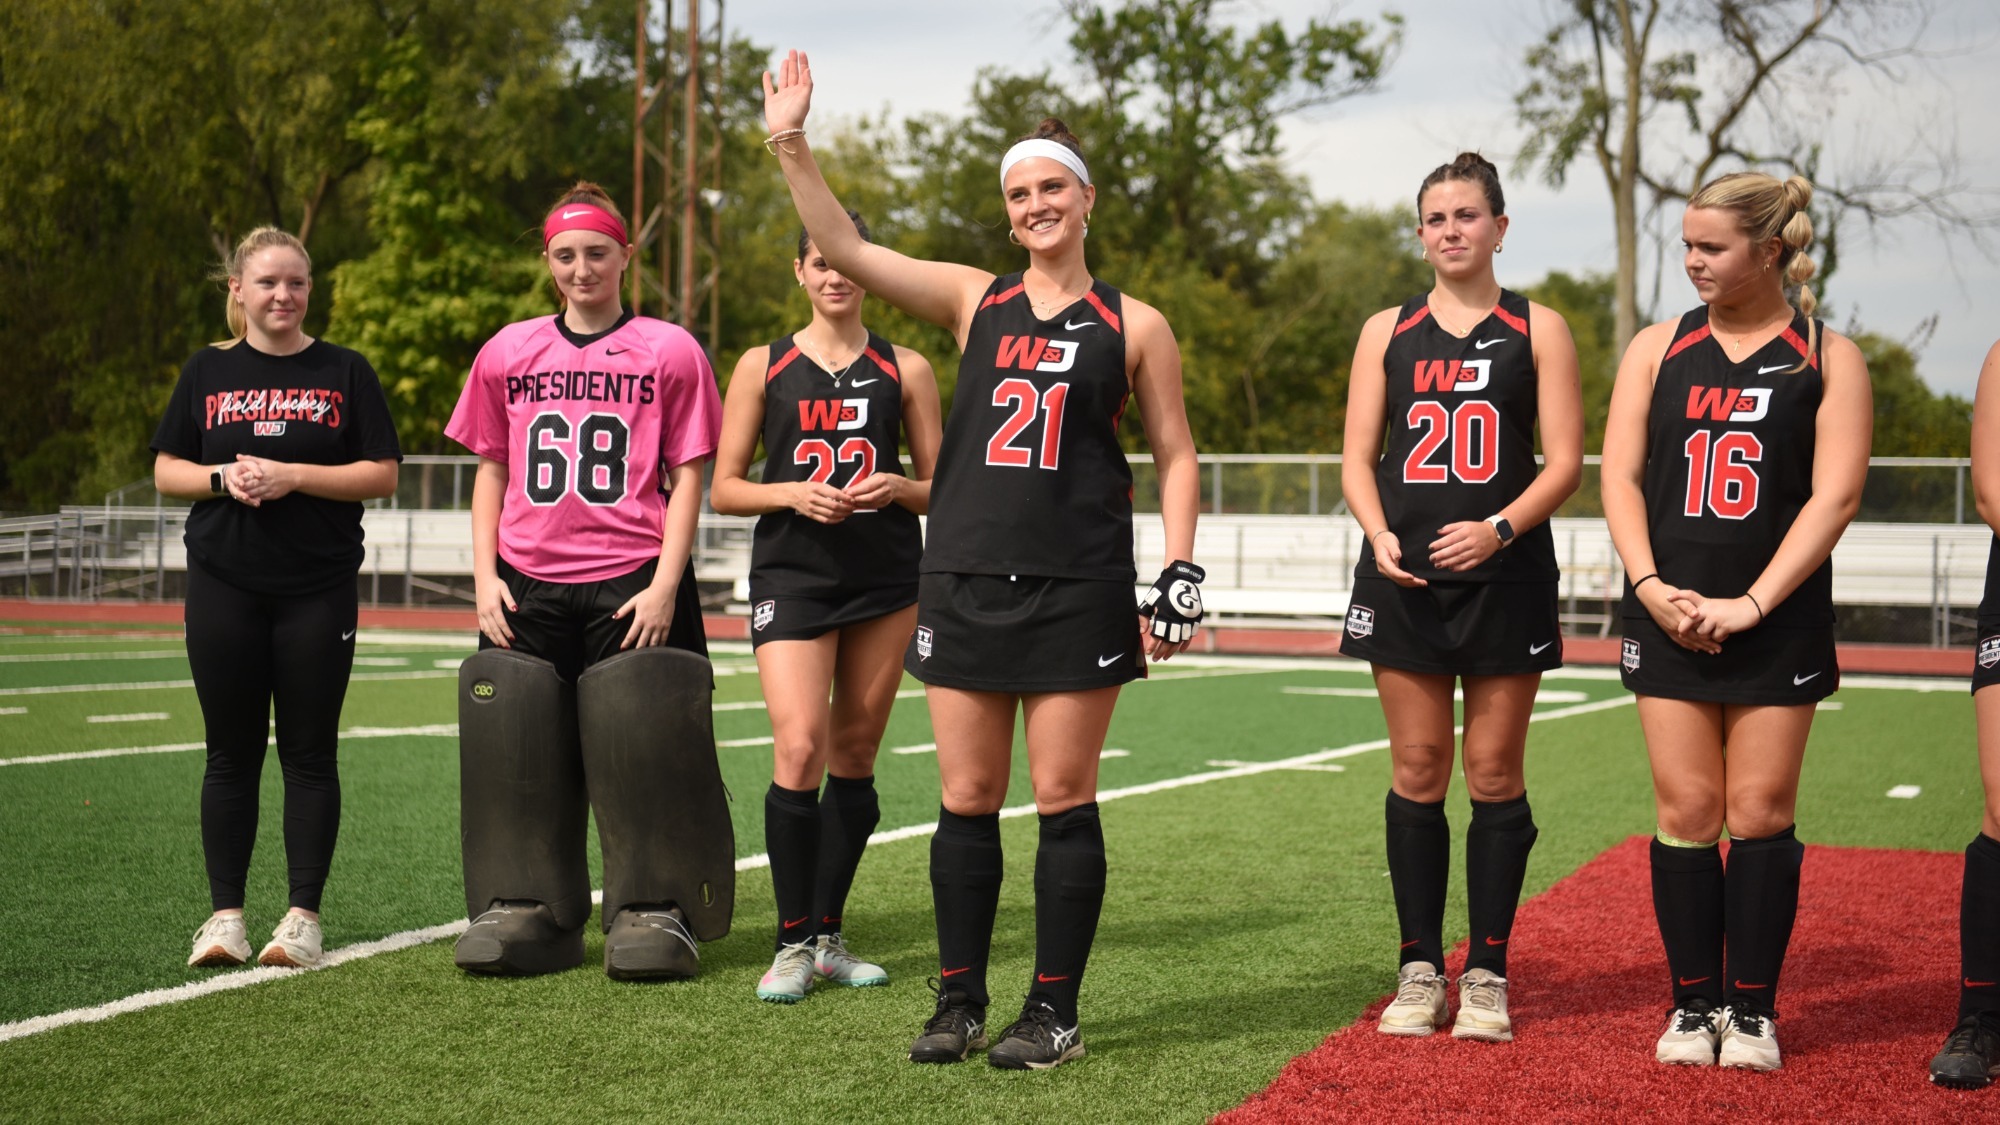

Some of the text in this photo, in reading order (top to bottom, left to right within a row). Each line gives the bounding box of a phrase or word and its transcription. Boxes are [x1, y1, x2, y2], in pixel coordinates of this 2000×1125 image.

[995, 335, 1080, 372] W&J
[506, 370, 656, 405] PRESIDENTS
[1413, 359, 1492, 393] W&J
[205, 388, 344, 430] PRESIDENTS
[217, 389, 332, 426] field hockey
[798, 398, 869, 431] W&J
[1685, 385, 1774, 422] W&J
[985, 377, 1070, 470] 21
[1403, 400, 1500, 484] 20
[524, 410, 631, 507] 68
[794, 437, 878, 513] 22
[1684, 429, 1763, 520] 16
